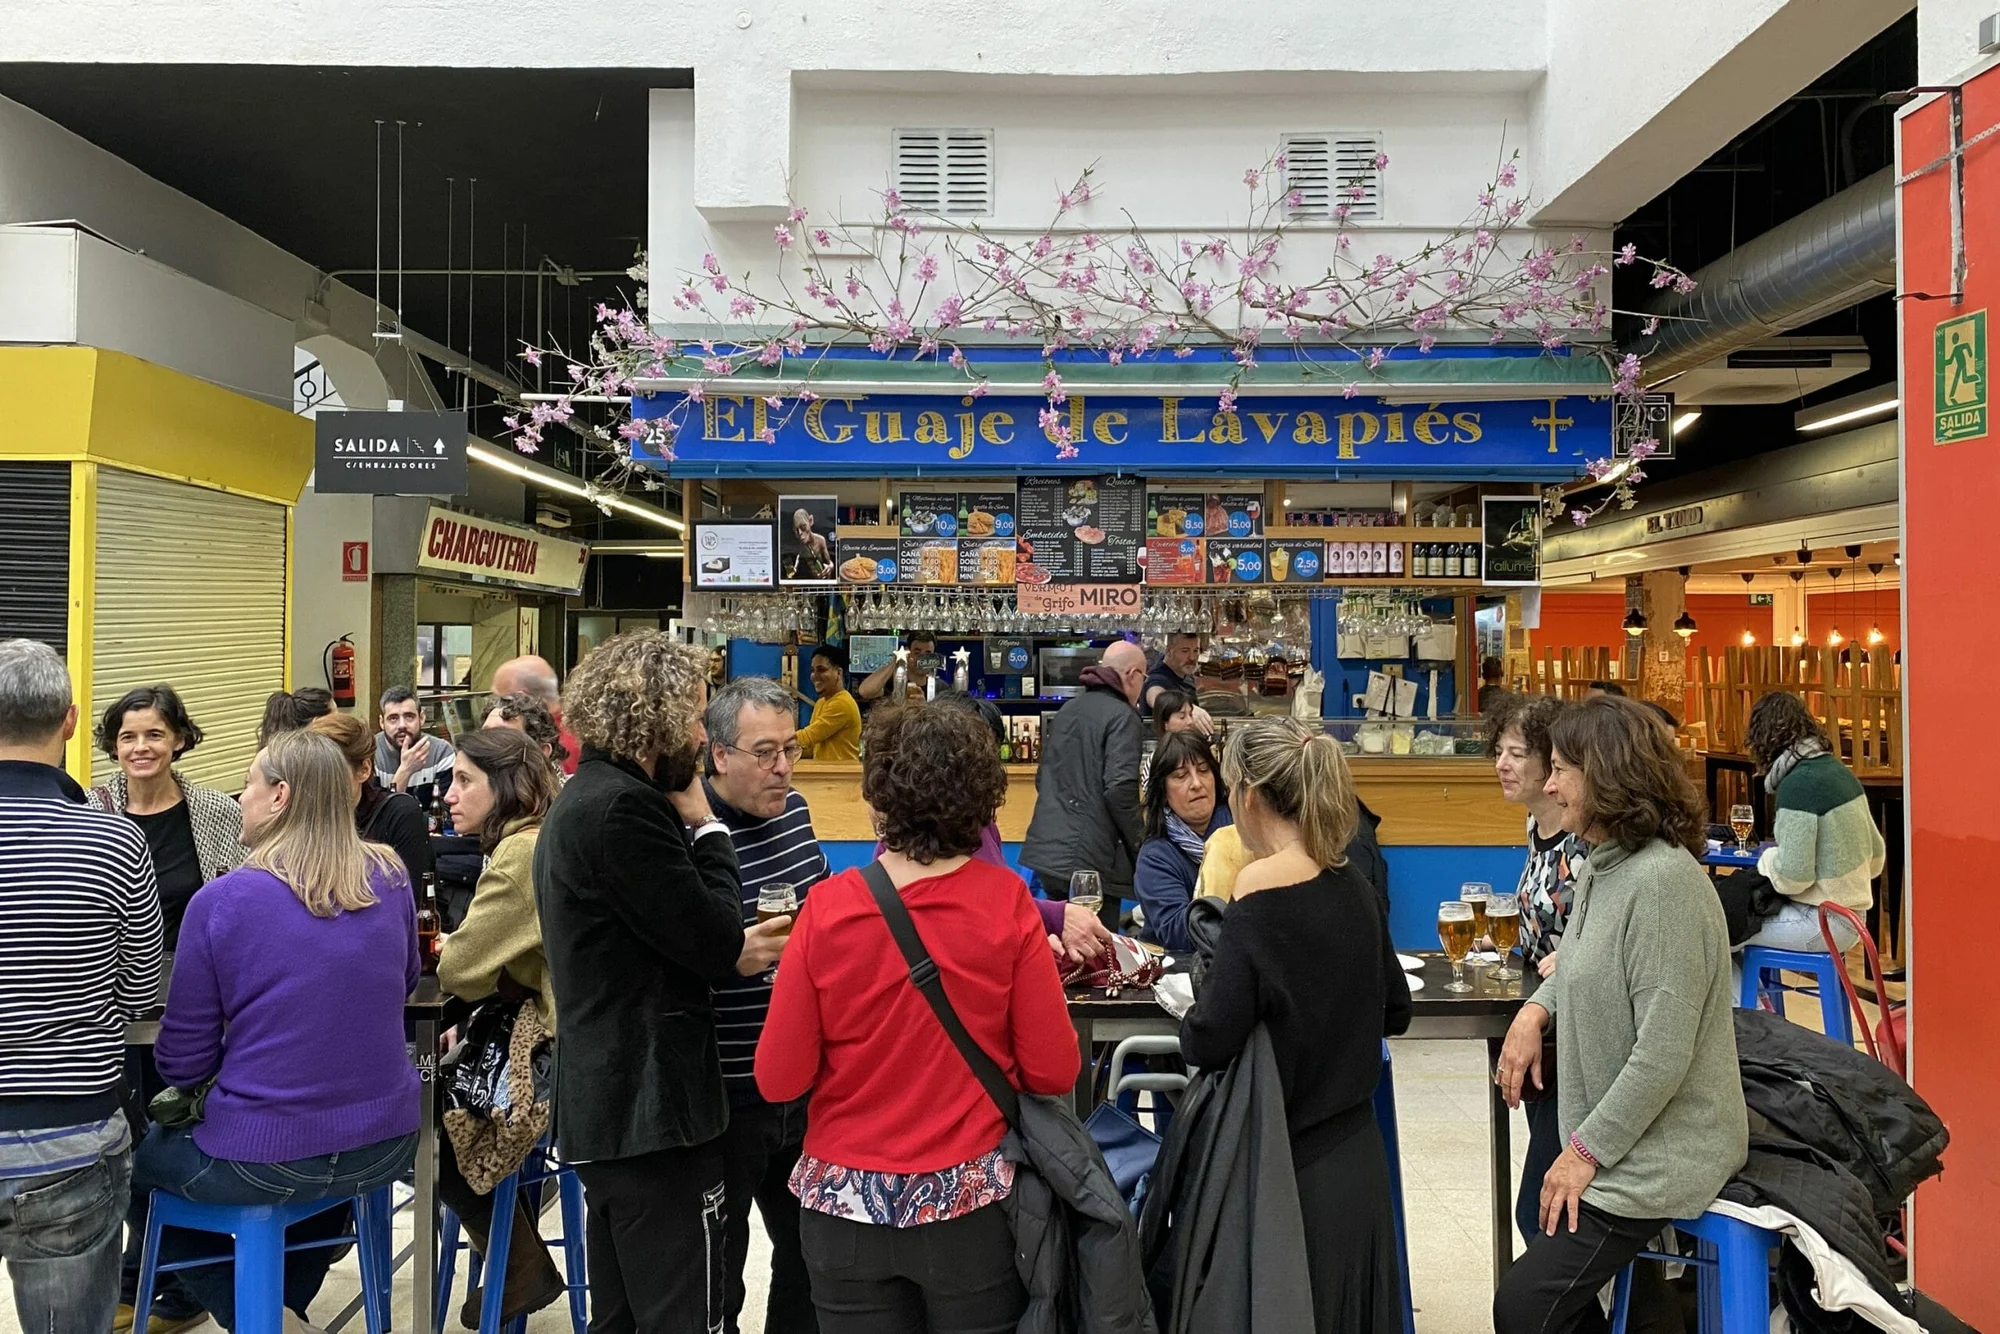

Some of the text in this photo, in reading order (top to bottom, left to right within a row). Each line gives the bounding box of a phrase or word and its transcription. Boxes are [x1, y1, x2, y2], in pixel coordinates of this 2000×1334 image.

[1939, 410, 1981, 430] SALIDA
[803, 397, 1015, 459] Guaje
[1044, 396, 1128, 444] de
[1158, 397, 1483, 459] Lavapiés
[644, 428, 666, 444] 25
[334, 438, 400, 452] SALIDA
[1024, 477, 1061, 486] Raciones
[1106, 477, 1136, 487] Quesos
[936, 521, 956, 530] 10,00
[995, 521, 1014, 530] 9,00
[1185, 521, 1203, 530] 8,50
[1228, 521, 1251, 529] 15,00
[1022, 529, 1068, 539] Embutidos
[1107, 535, 1137, 546] Tostas
[427, 517, 539, 575] CHARCUTERIA
[1180, 545, 1195, 553] 5,00
[901, 550, 921, 558] CAÑA
[960, 550, 980, 558] CAÑA
[1237, 559, 1262, 571] 5,00
[1297, 558, 1318, 568] 2,50
[877, 564, 897, 575] 3,00
[1042, 597, 1074, 612] Grifo
[1010, 655, 1028, 663] 5,00
